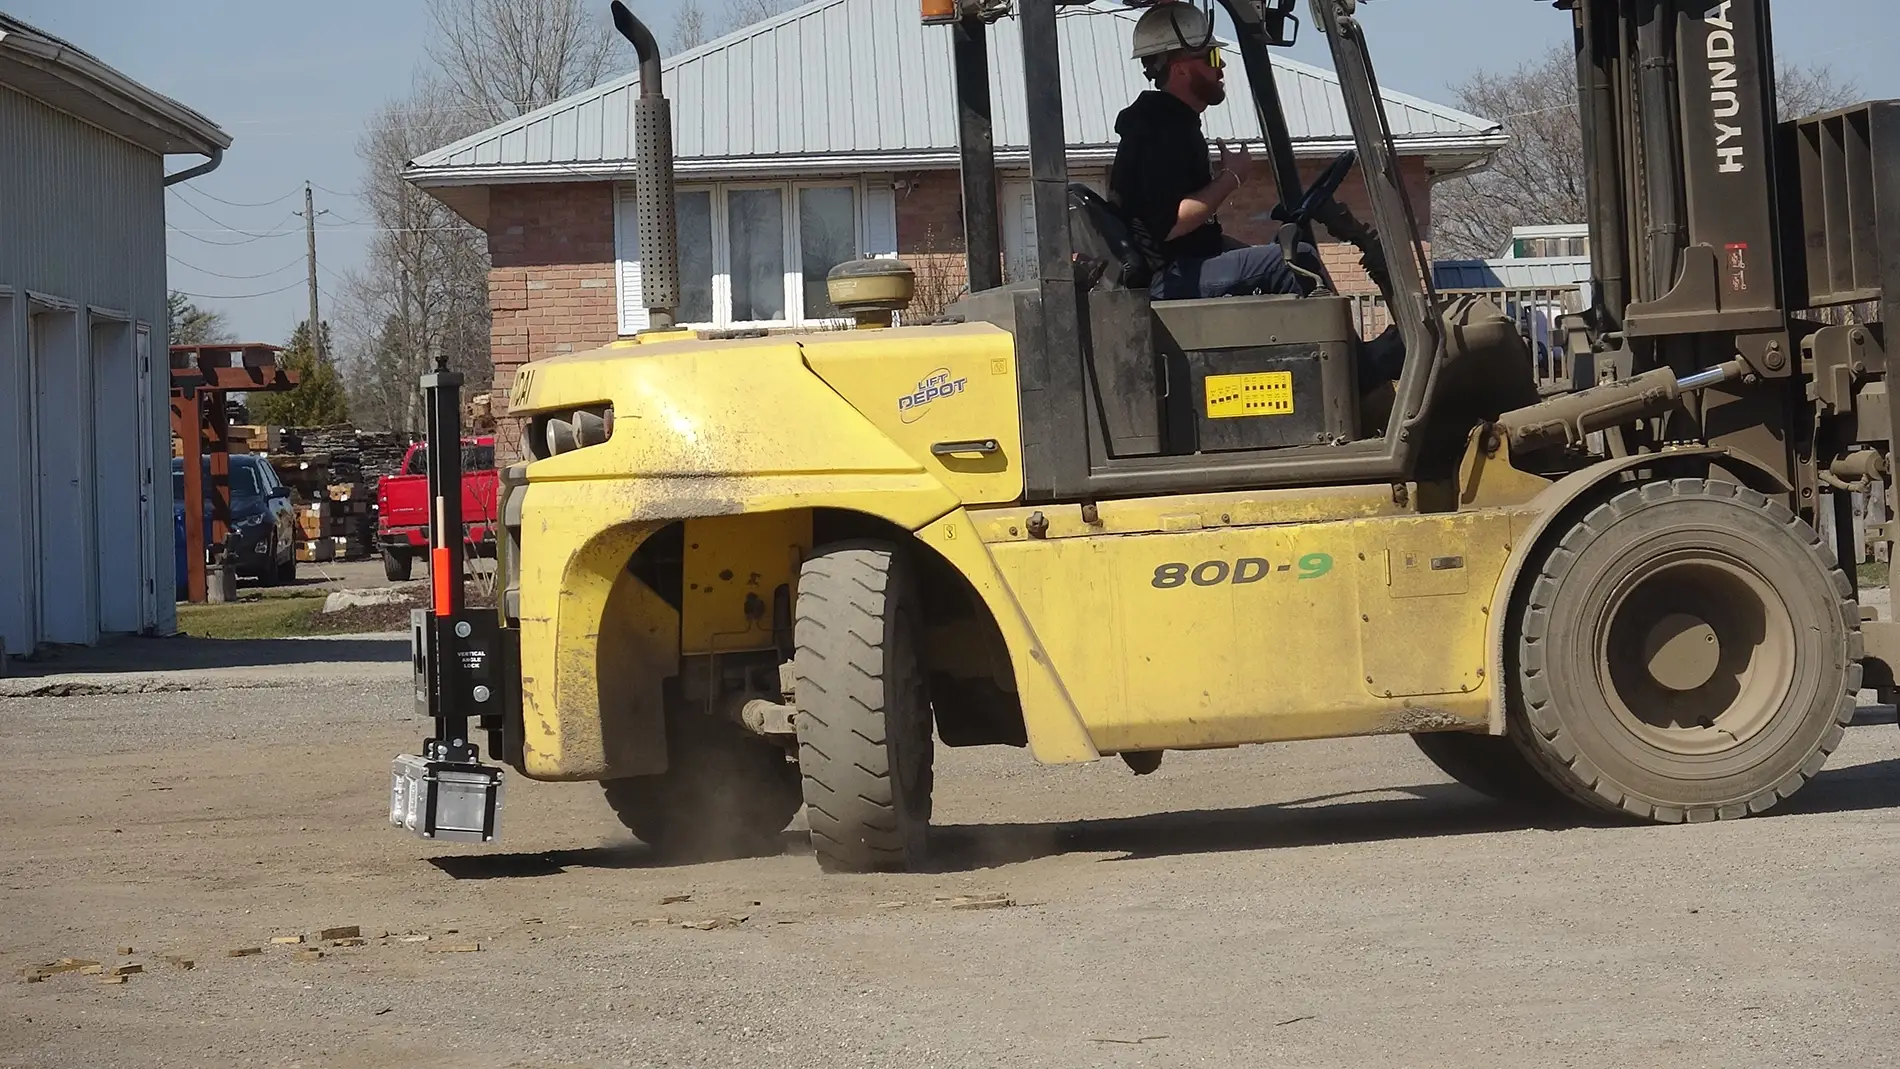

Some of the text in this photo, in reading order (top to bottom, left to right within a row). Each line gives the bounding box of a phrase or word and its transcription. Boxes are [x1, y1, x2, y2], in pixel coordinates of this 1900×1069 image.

[898, 378, 967, 411] DEPOT
[917, 373, 948, 391] LIFT
[1151, 552, 1334, 589] 80D-9
